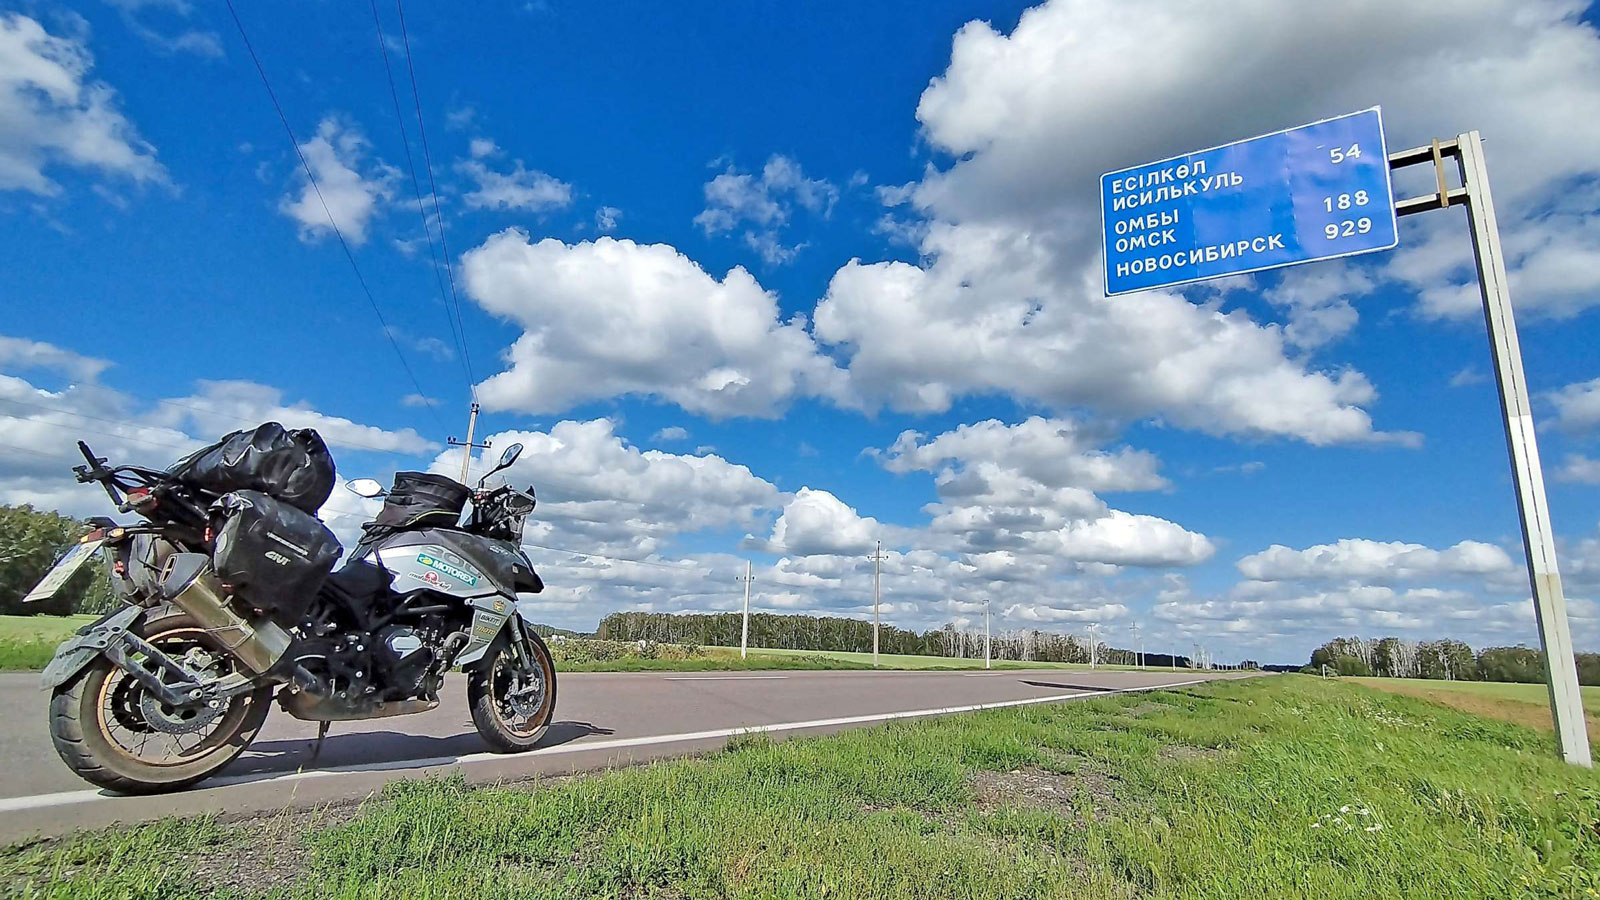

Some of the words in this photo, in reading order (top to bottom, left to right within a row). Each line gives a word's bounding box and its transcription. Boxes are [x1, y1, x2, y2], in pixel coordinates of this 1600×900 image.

[1112, 160, 1206, 194] ЕСІЛКӨЛ
[1113, 171, 1243, 211] ИСИЛЬКУЛЬ
[1330, 144, 1362, 164] 54
[1115, 229, 1176, 253] ОМСК
[1323, 190, 1369, 213] 188
[1115, 209, 1179, 235] ОМБЫ
[1116, 233, 1285, 277] НОВОСИБИРСК
[1324, 217, 1372, 240] 929
[432, 560, 474, 585] MOTOREX
